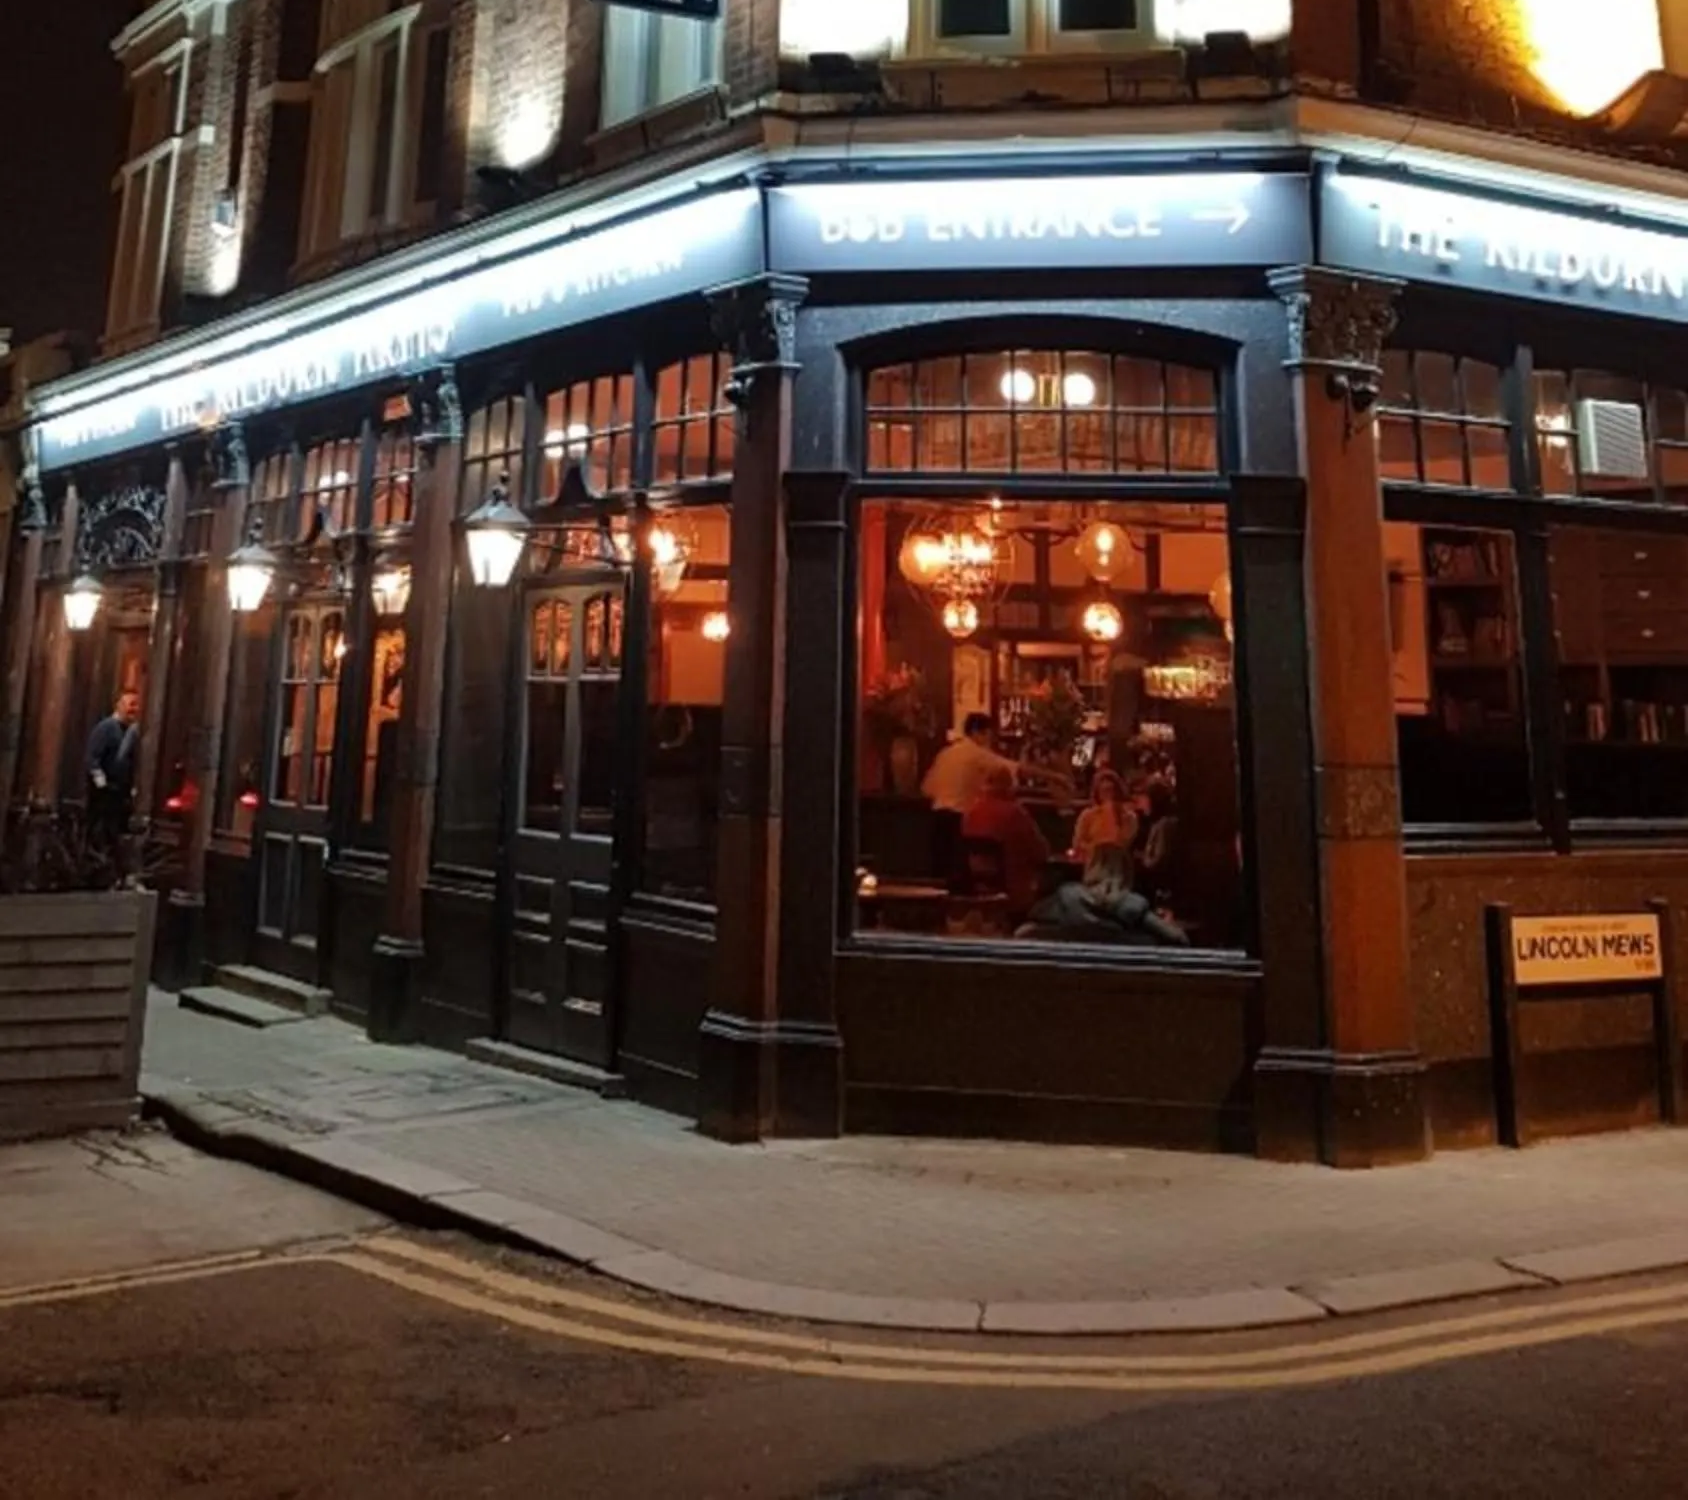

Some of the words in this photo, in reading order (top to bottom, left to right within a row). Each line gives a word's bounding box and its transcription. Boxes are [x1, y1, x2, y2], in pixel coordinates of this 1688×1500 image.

[928, 192, 1164, 241] ENTRANCE
[1517, 933, 1597, 961] LINCOLN
[1601, 933, 1655, 958] MEWS
